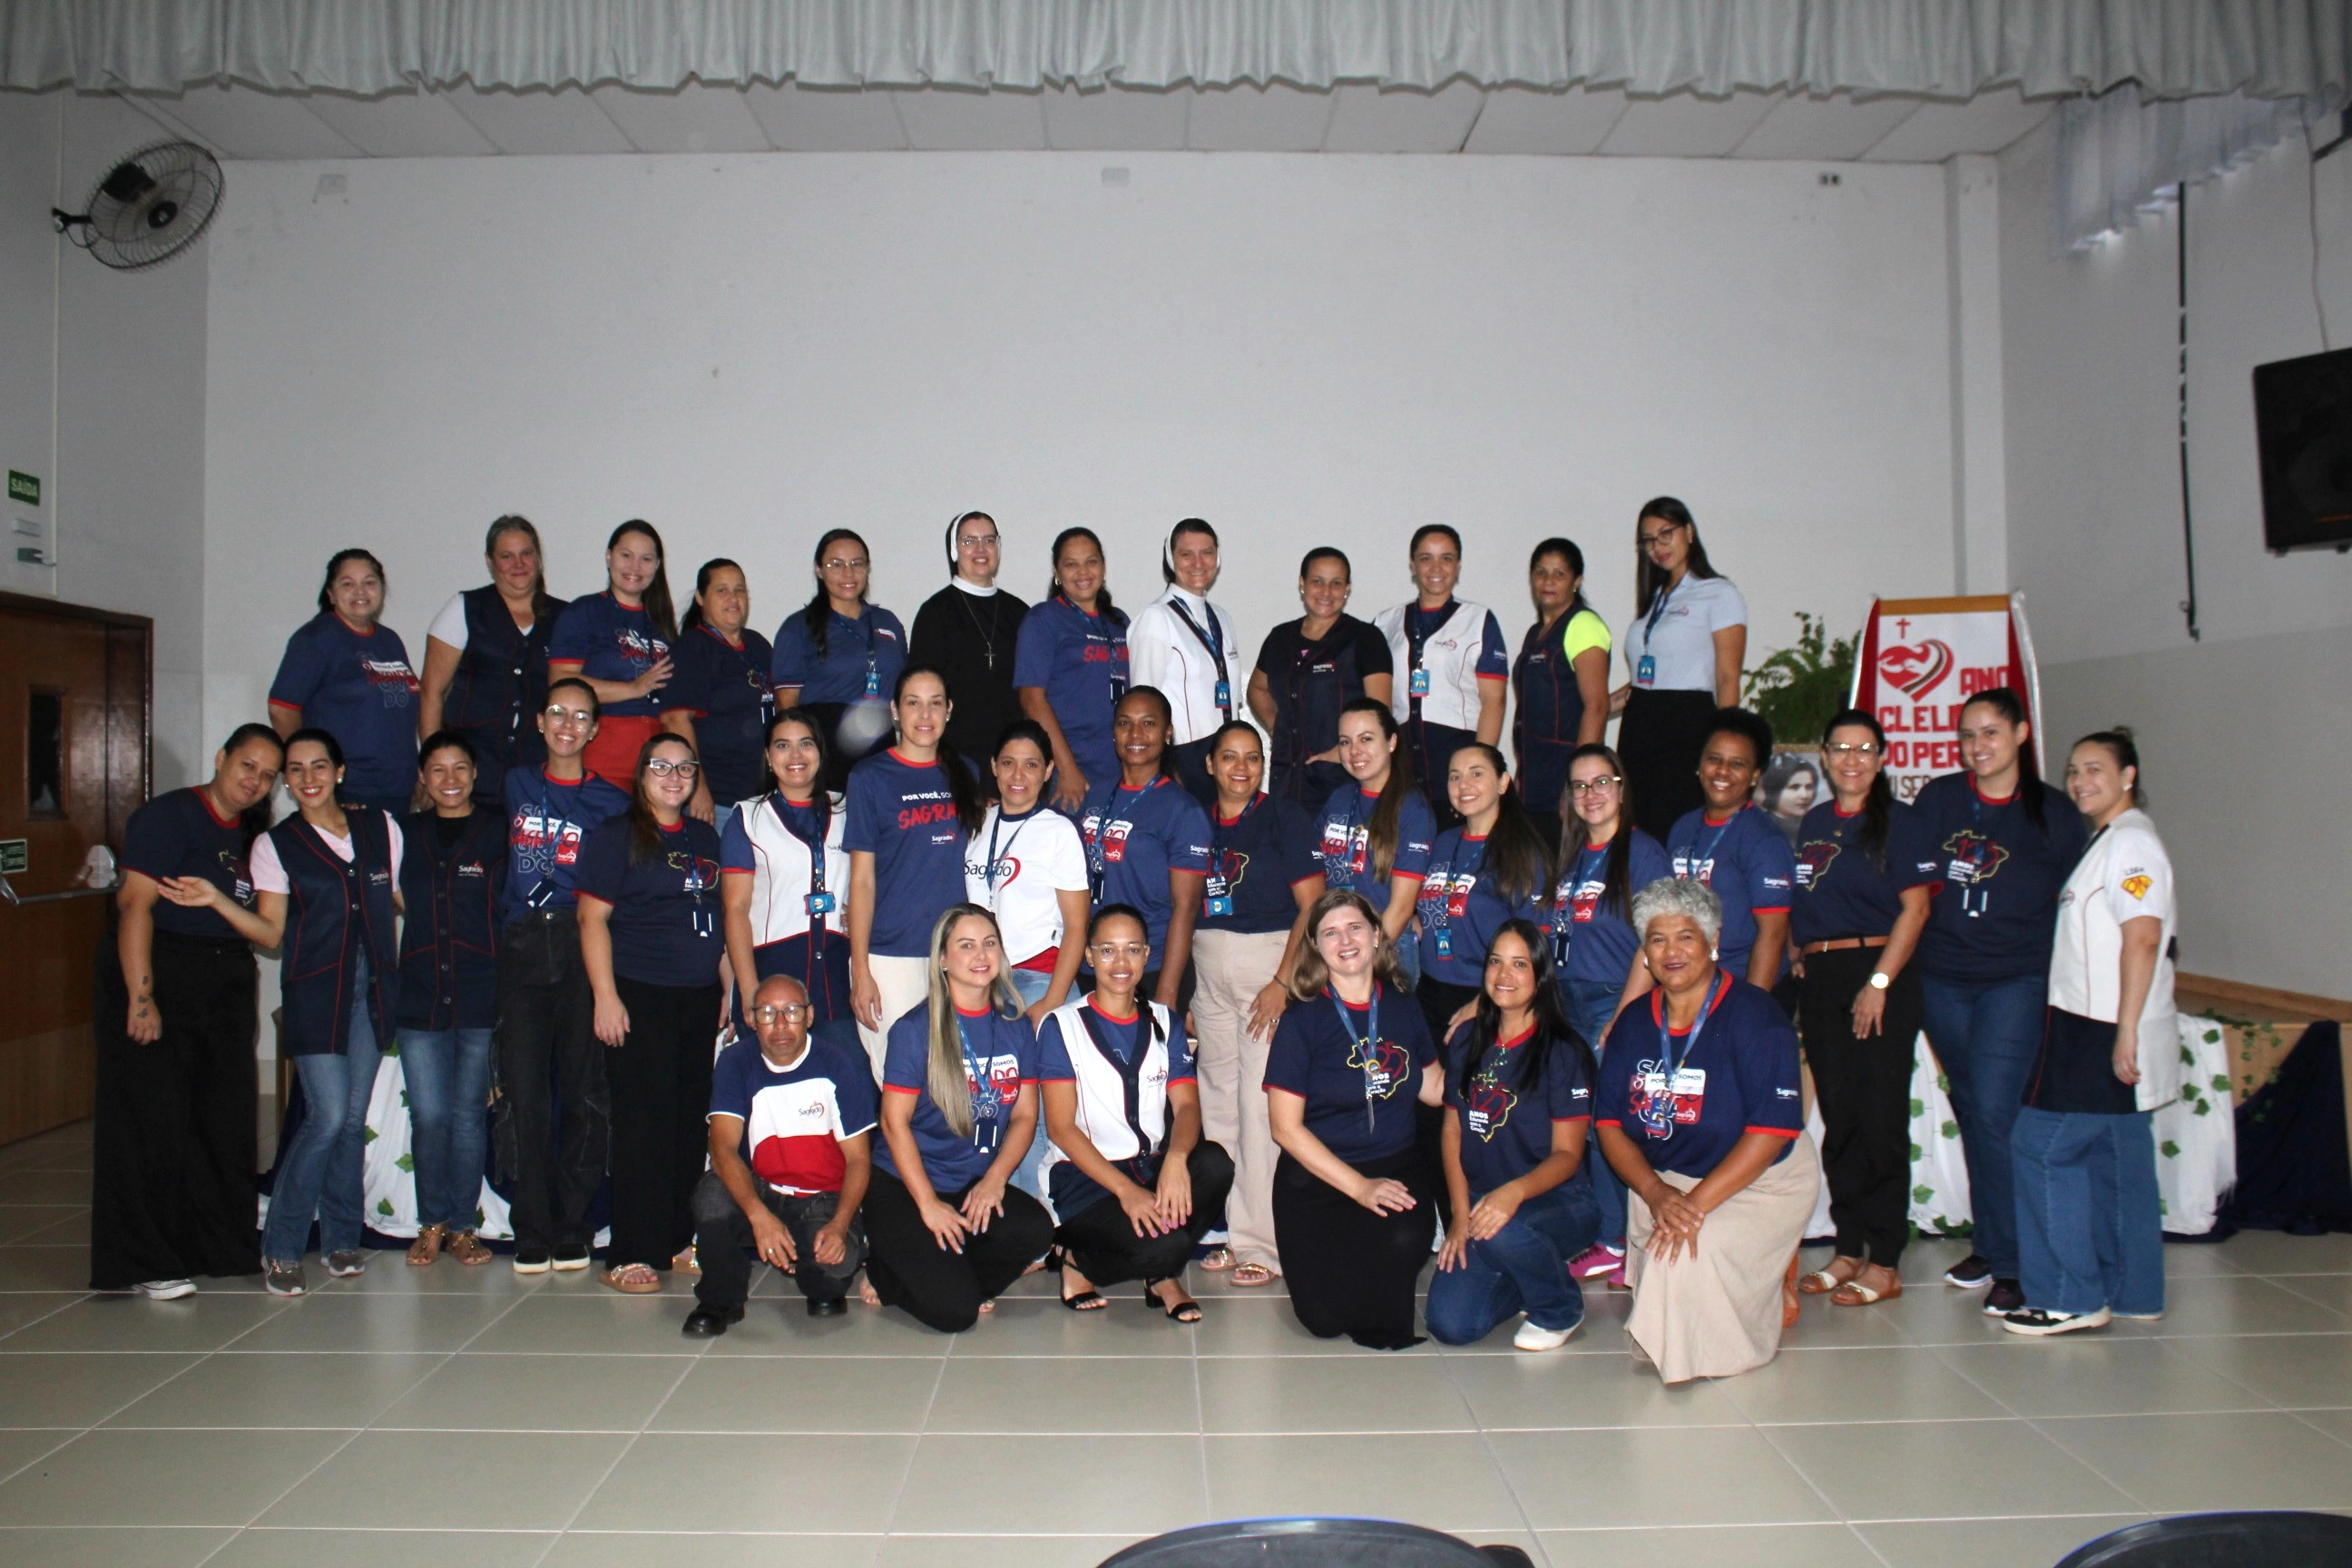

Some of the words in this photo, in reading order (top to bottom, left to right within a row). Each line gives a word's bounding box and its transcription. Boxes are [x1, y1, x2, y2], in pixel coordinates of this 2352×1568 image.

[902, 793, 919, 802] POR
[918, 790, 941, 799] VOCÊ,
[931, 834, 953, 842] Sagrado
[458, 865, 484, 874] Sagrado
[965, 859, 1012, 879] Sagdo
[1207, 876, 1225, 885] ANS
[1764, 877, 1788, 887] Sagrado
[993, 1059, 1014, 1067] SOMOS
[1373, 1073, 1390, 1081] NOS
[799, 1106, 821, 1117] Sagrado
[1469, 1110, 1488, 1119] ANOS
